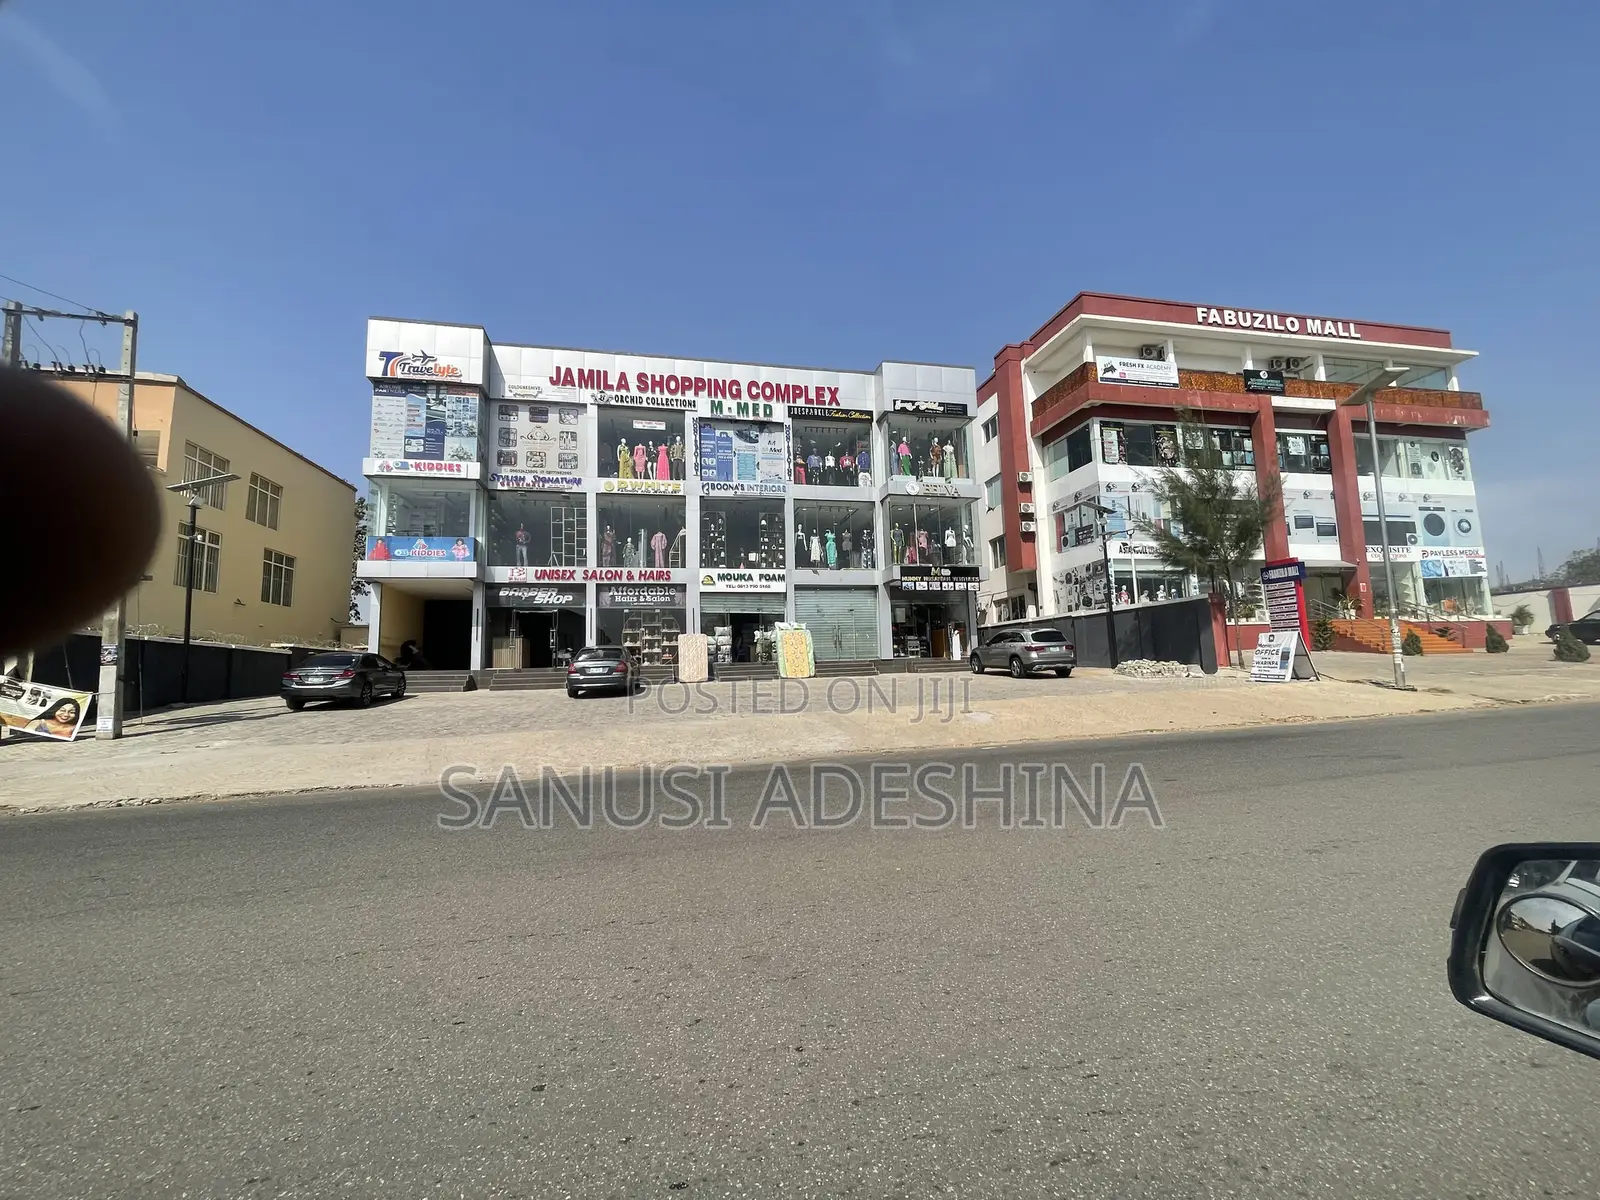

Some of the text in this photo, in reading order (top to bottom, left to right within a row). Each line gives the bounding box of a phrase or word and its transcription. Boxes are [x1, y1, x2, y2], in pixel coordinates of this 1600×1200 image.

[1196, 306, 1361, 339] FABUZILO MALL
[400, 363, 463, 377] Travelyte
[1146, 364, 1172, 372] ACADEMY
[549, 366, 841, 407] JAMILA SHOPPING COMPLEX
[614, 394, 697, 409] ORCHID COLLECTIONS
[790, 407, 829, 417] JOESPARKLE
[414, 461, 462, 473] KIDDIES
[490, 473, 582, 486] STYLISH SIGNATURE
[710, 482, 787, 493] BOONA'S INTERIORS
[1365, 546, 1412, 554] EXQISITE
[534, 569, 577, 581] UNISEX
[582, 570, 621, 581] SALON
[626, 570, 635, 581] &
[638, 570, 672, 582] HAIRS
[717, 573, 785, 583] MOUKA FOAM
[499, 588, 558, 598] BARBER
[608, 586, 676, 596] Affordable
[533, 592, 573, 604] SHOP
[646, 594, 671, 602] Salon
